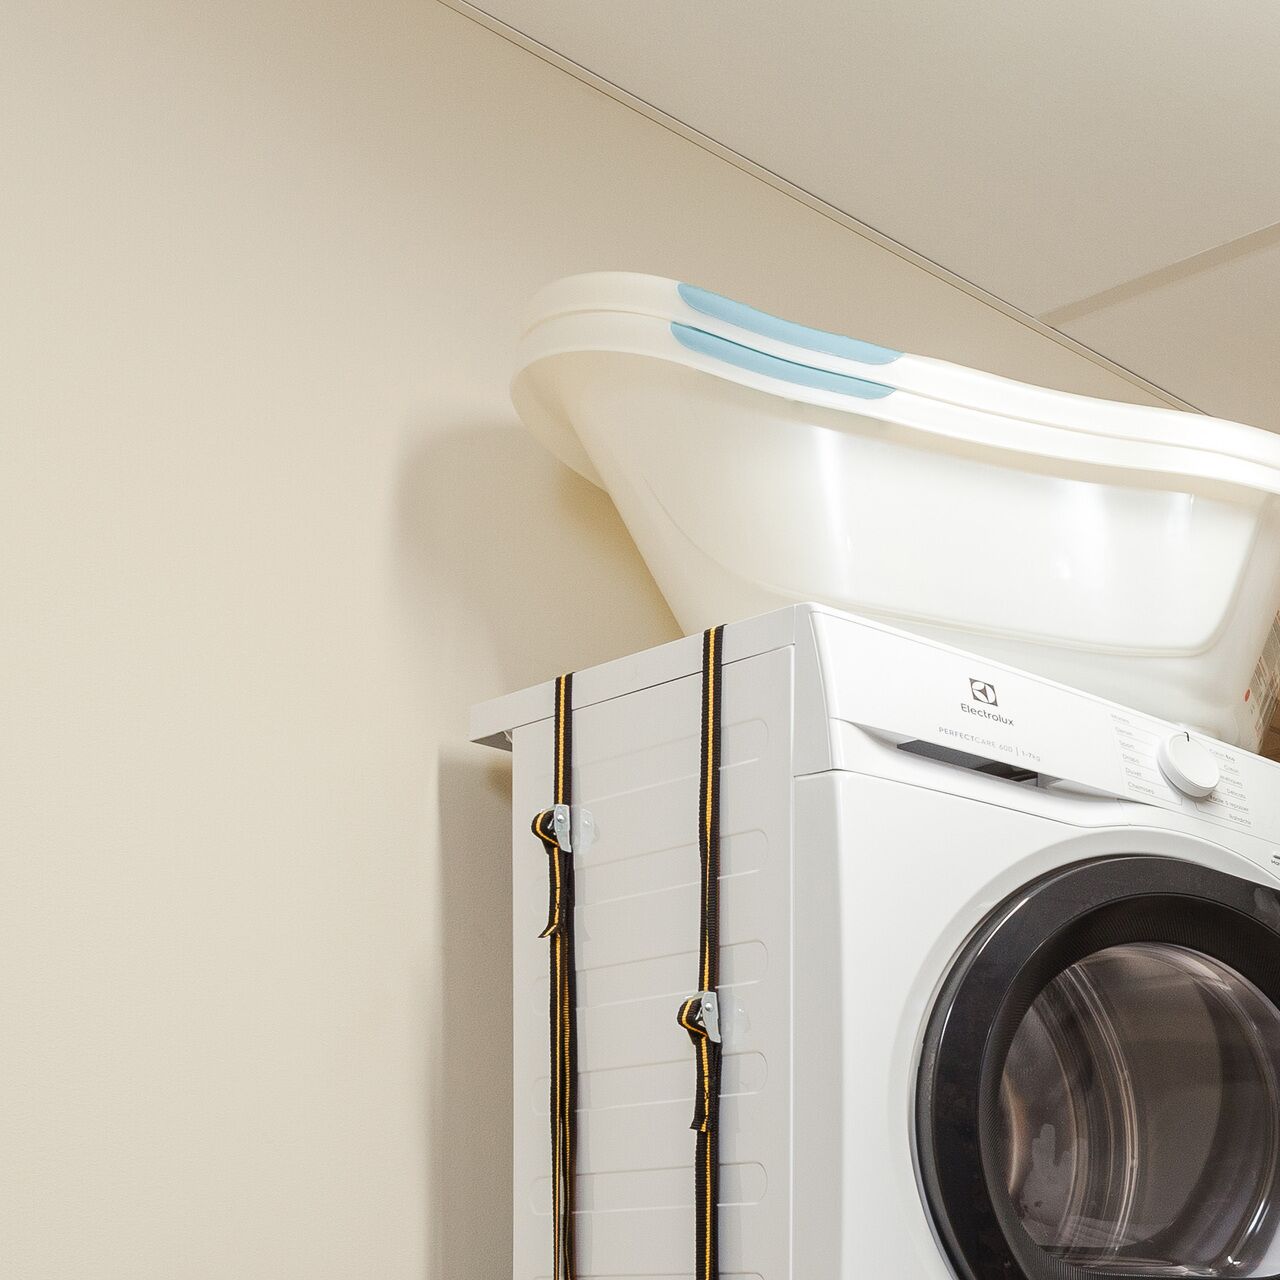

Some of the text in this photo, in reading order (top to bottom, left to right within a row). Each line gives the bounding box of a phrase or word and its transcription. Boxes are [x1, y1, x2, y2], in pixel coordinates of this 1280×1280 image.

[961, 703, 1014, 726] Electrolux
[939, 727, 996, 748] PERFECTCARE
[999, 744, 1012, 752] 600
